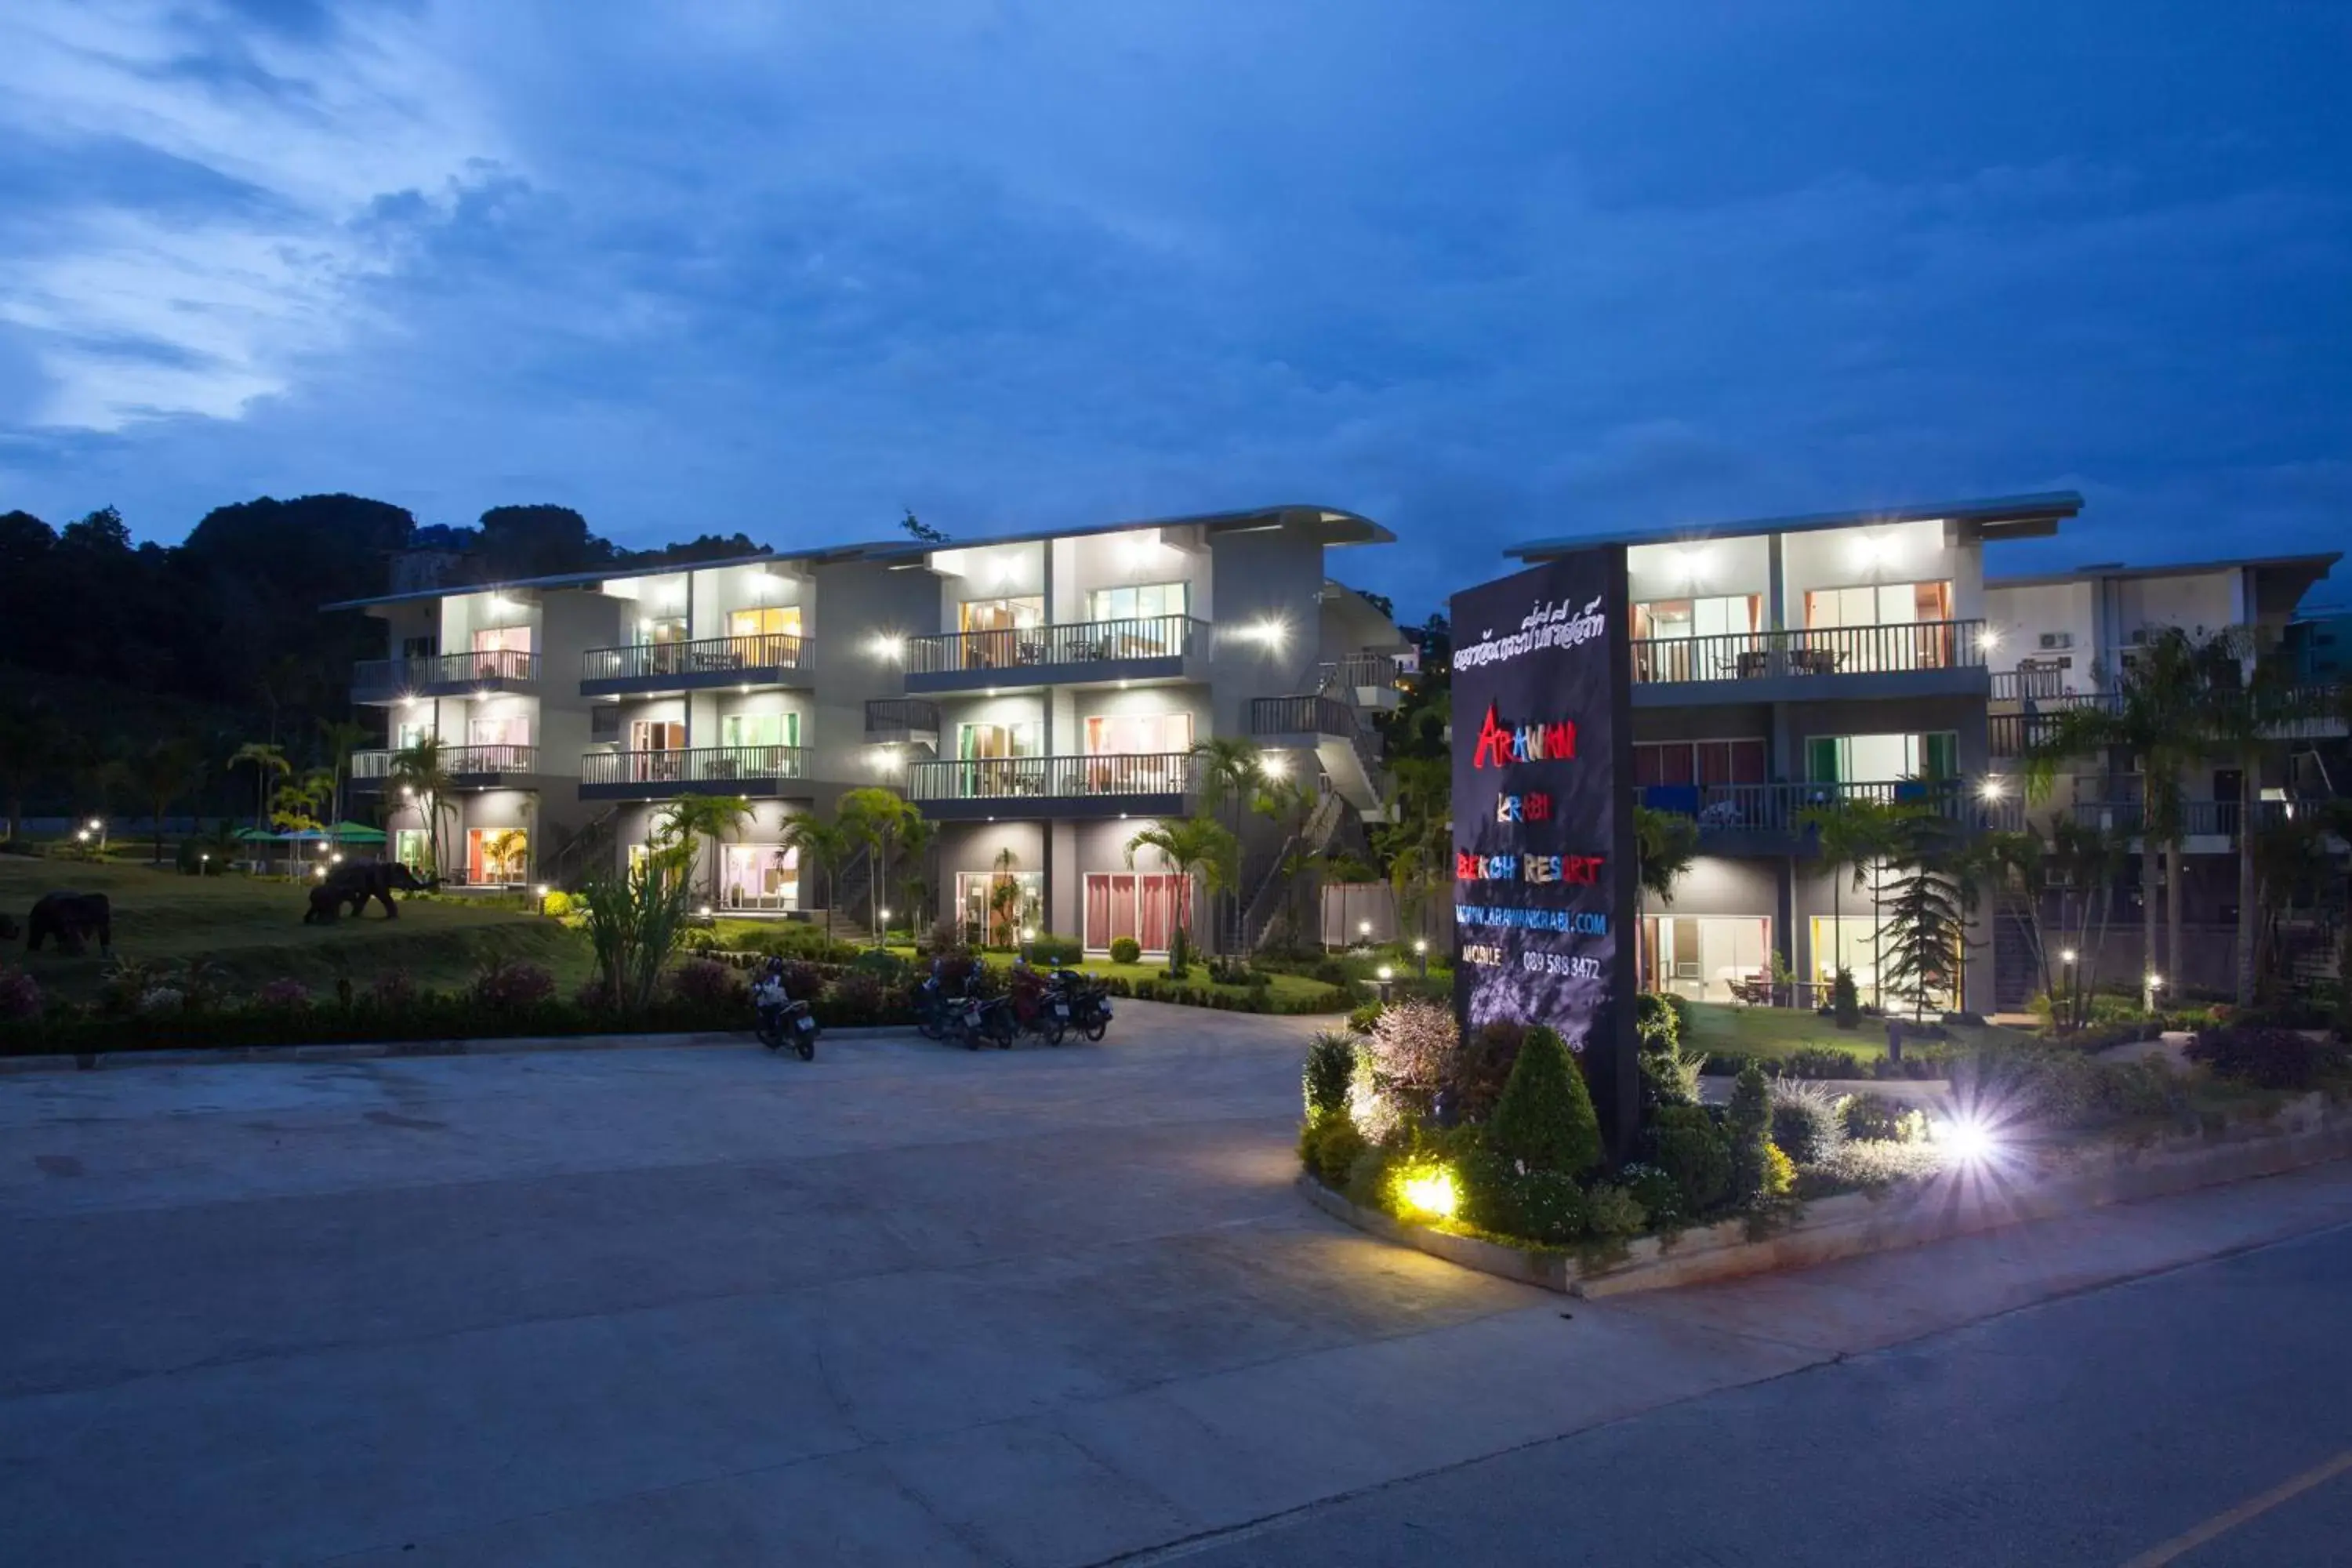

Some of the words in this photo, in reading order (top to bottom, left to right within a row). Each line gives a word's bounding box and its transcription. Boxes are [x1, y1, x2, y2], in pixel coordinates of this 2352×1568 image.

[1497, 792, 1552, 822] KRABI
[1523, 853, 1605, 886] RESORT
[1462, 944, 1501, 967] MOBILE
[1523, 950, 1544, 971] 089
[1570, 956, 1600, 979] 3472
